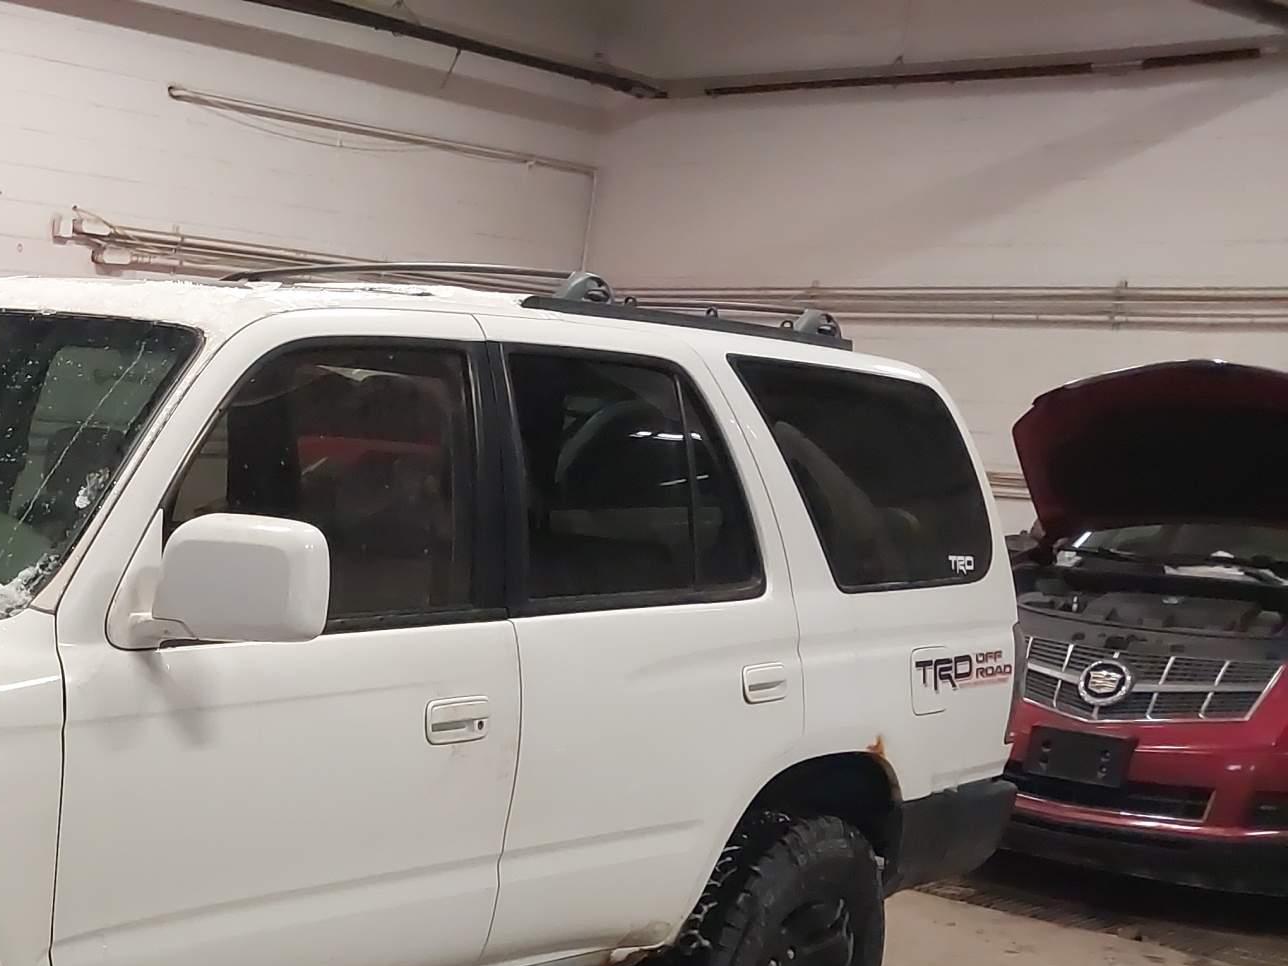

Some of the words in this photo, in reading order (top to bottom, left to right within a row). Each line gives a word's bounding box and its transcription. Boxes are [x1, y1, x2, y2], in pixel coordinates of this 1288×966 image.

[948, 555, 975, 575] TRD
[915, 655, 973, 692] TRD
[976, 651, 1003, 663] OFF
[976, 664, 1013, 679] ROAD
